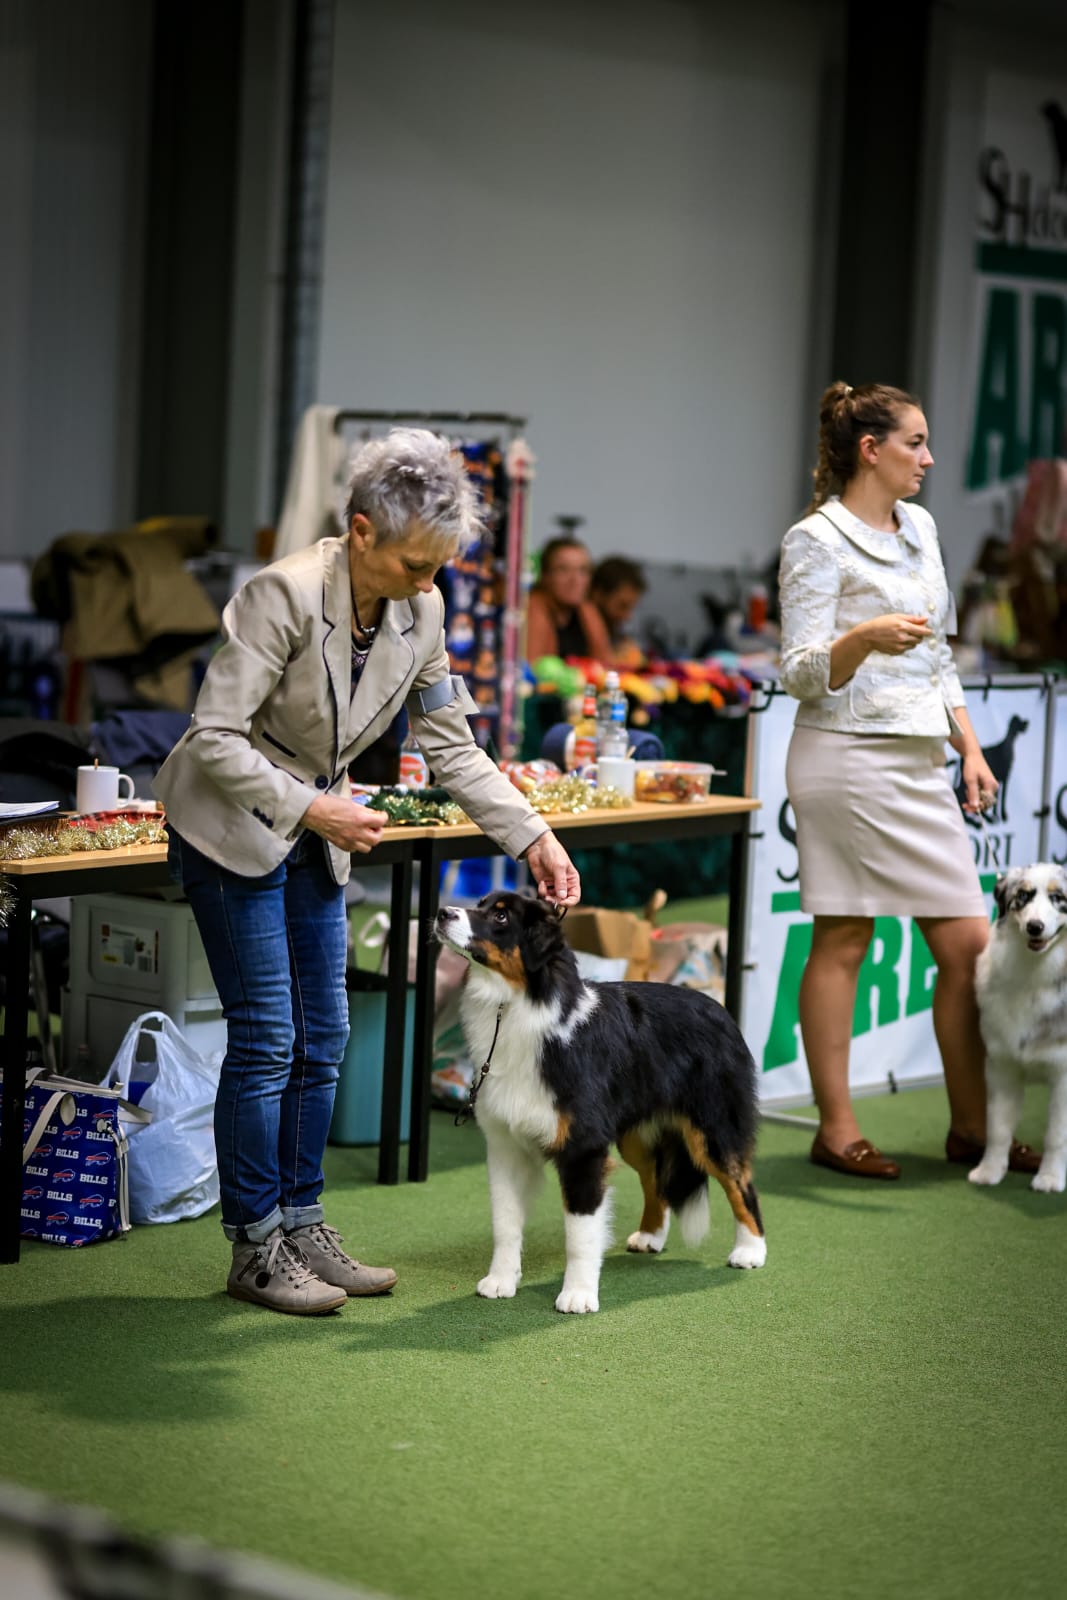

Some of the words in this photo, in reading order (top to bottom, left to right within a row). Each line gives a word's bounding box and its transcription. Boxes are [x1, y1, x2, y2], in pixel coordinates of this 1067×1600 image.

[85, 1130, 114, 1142] BILLS
[55, 1148, 80, 1160] BILLS
[25, 1165, 48, 1177] BILLS
[79, 1173, 109, 1185] BILLS
[46, 1190, 73, 1202] BILLS
[73, 1216, 103, 1228] BILLS
[41, 1233, 68, 1244] BILLS
